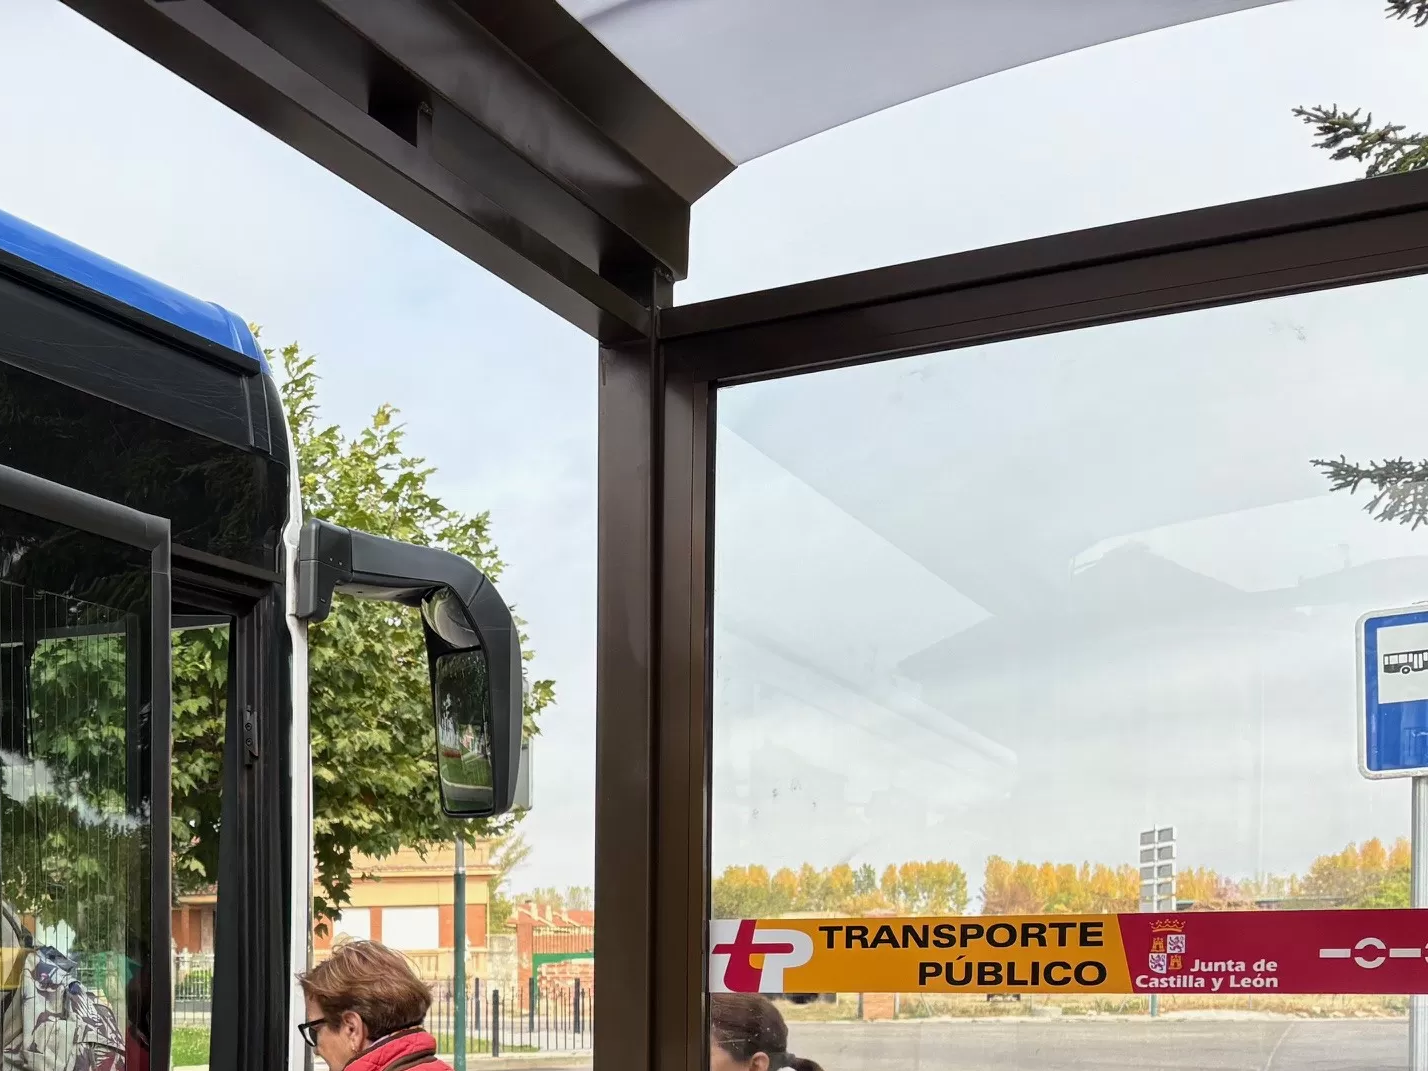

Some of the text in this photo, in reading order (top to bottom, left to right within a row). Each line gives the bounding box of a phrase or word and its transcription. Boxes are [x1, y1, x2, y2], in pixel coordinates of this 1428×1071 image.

[818, 921, 1104, 949] TRANSPORTE
[918, 954, 1107, 986] PÚBLICO
[1190, 959, 1278, 972] Junta de
[1135, 974, 1279, 992] Castilla y León
